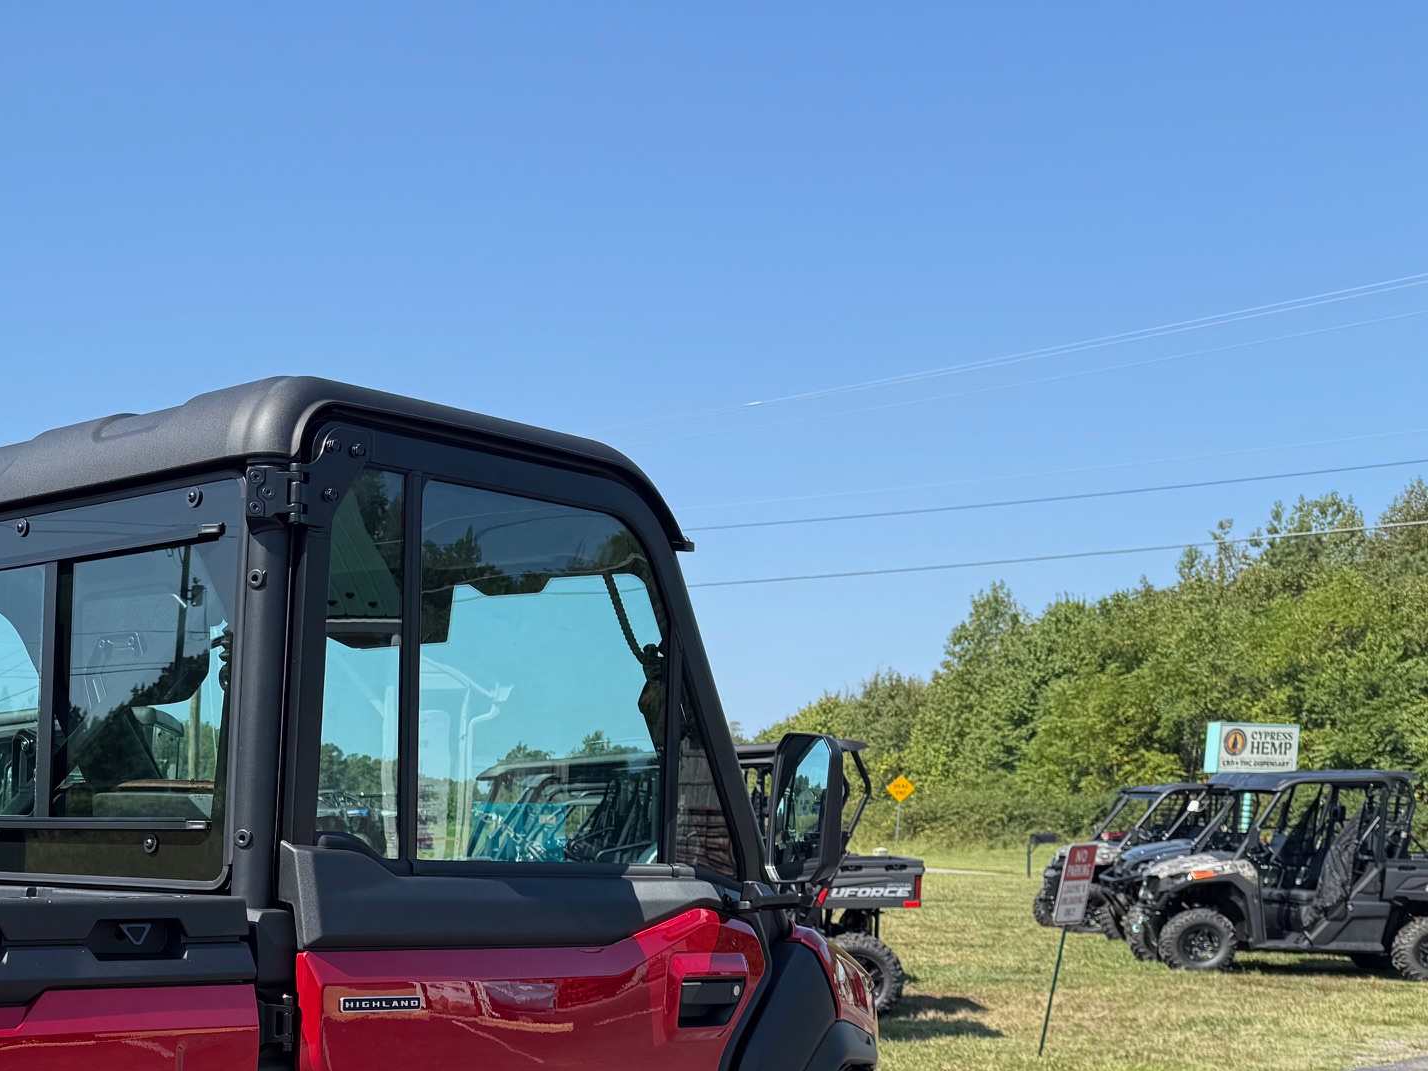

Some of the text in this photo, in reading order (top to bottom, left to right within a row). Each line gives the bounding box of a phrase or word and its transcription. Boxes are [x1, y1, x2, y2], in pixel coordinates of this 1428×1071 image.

[1251, 730, 1294, 741] CYPRESS
[1250, 741, 1292, 755] HEMP
[1075, 849, 1089, 863] NO
[830, 887, 912, 898] UFORCE
[345, 1000, 419, 1008] HIGHLAND
